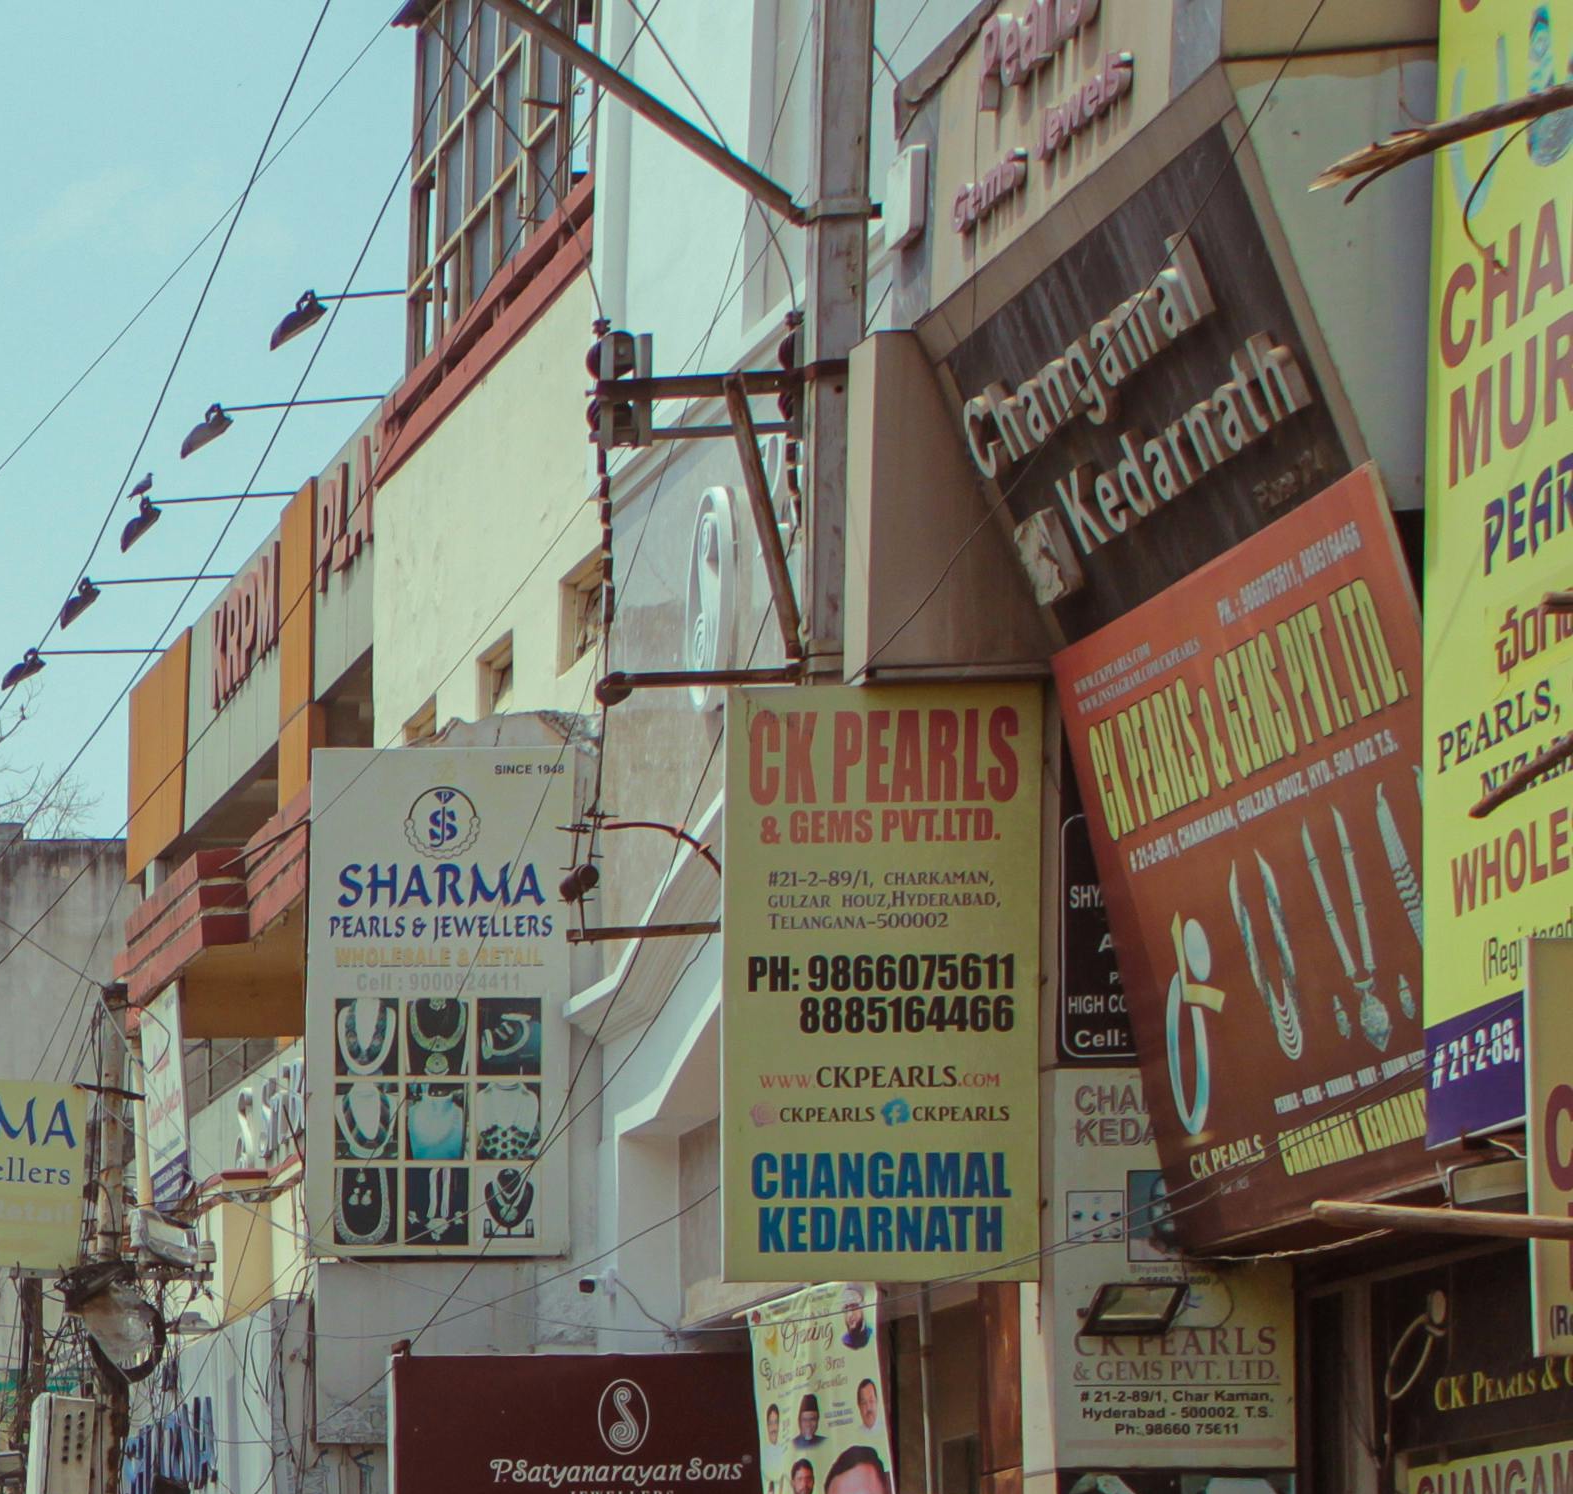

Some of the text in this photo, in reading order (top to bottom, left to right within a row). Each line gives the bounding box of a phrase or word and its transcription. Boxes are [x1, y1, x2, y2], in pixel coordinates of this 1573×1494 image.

[1440, 196, 1573, 368] CHA
[963, 232, 1216, 479] Changamal
[1056, 331, 1312, 555] Kedarnath
[212, 541, 281, 711] KRPM
[1213, 631, 1298, 780] GEMS
[1197, 684, 1234, 790] &
[1437, 678, 1561, 774] PEARLS,
[494, 764, 533, 775] SINCE
[749, 705, 1019, 806] CK PEARLS
[1118, 676, 1210, 832] PEARLS
[1088, 716, 1136, 842] CK
[760, 815, 781, 844] &
[789, 809, 873, 844] GEMS
[337, 861, 546, 908] SHARMA
[884, 870, 995, 888] CHARKAMAN,
[1069, 886, 1105, 908] SHY
[768, 895, 831, 908] GULZAR
[329, 914, 553, 943] PEARLS & JEWELLERS
[335, 947, 451, 968] WHOLESALE
[477, 947, 545, 968] RETAIL
[748, 953, 1015, 992] PH: 9866075611
[800, 995, 1014, 1033] 8885164466
[1068, 996, 1104, 1015] HIGH
[1075, 1029, 1128, 1049] Cell:
[779, 1105, 1010, 1123] CKPEARLS CKPEARLS
[1189, 1151, 1213, 1180] CK
[1210, 1134, 1265, 1172] PEARLS
[751, 1152, 1011, 1199] CHANGAMAL
[758, 1206, 1003, 1254] KEDARNATH
[1137, 1326, 1277, 1357] PEARLS
[1073, 1361, 1090, 1381] &
[1096, 1360, 1163, 1381] GEMS
[1170, 1360, 1221, 1381] PVT.
[1172, 1390, 1210, 1403] Char
[1434, 1376, 1464, 1412] CK
[1082, 1407, 1166, 1421] Hyderabad
[1145, 1423, 1191, 1436] 98660
[685, 1457, 743, 1481] Sons
